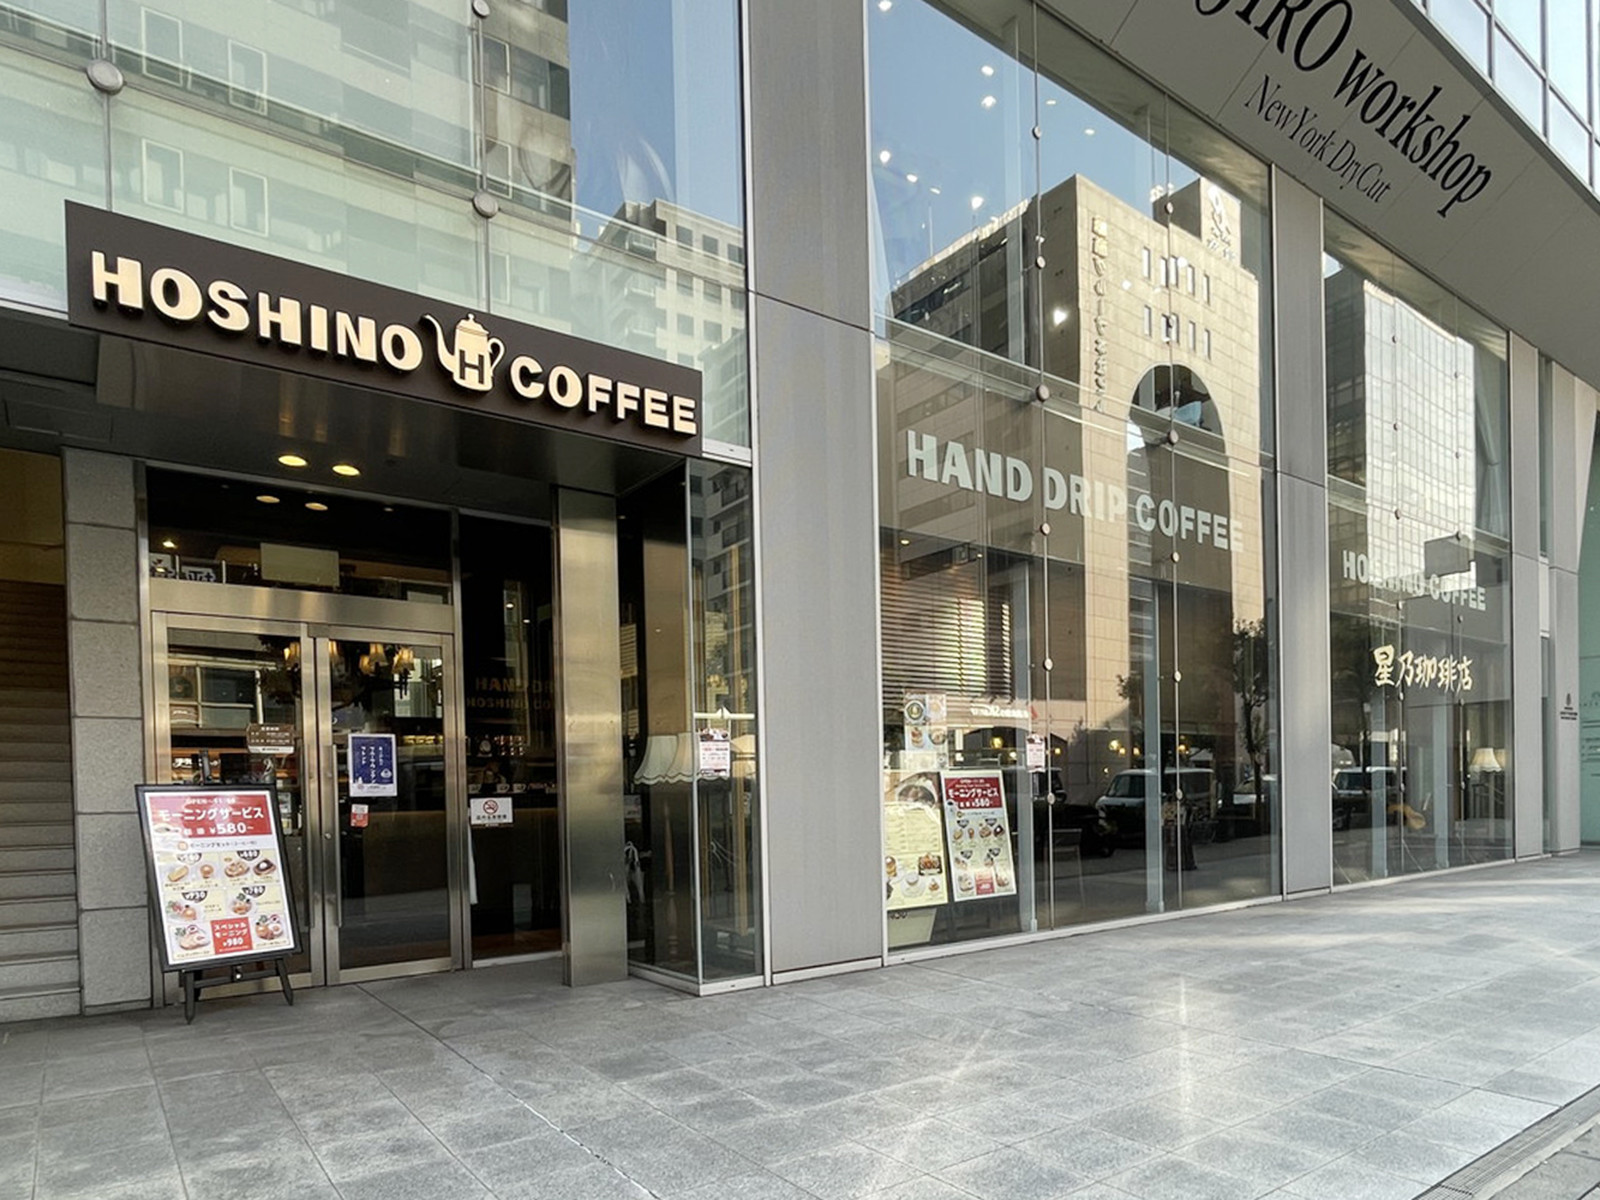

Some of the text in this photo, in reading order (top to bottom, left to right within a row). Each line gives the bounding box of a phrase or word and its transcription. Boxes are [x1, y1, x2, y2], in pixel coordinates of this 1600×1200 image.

[1195, 0, 1492, 218] RO workshop
[92, 250, 424, 372] HOSHINO
[510, 355, 698, 435] COFFEE
[907, 430, 1245, 554] HAND DRIP COFFEE
[1373, 644, 1473, 694] 星乃珈琲店
[158, 806, 265, 822] モーニングサービス
